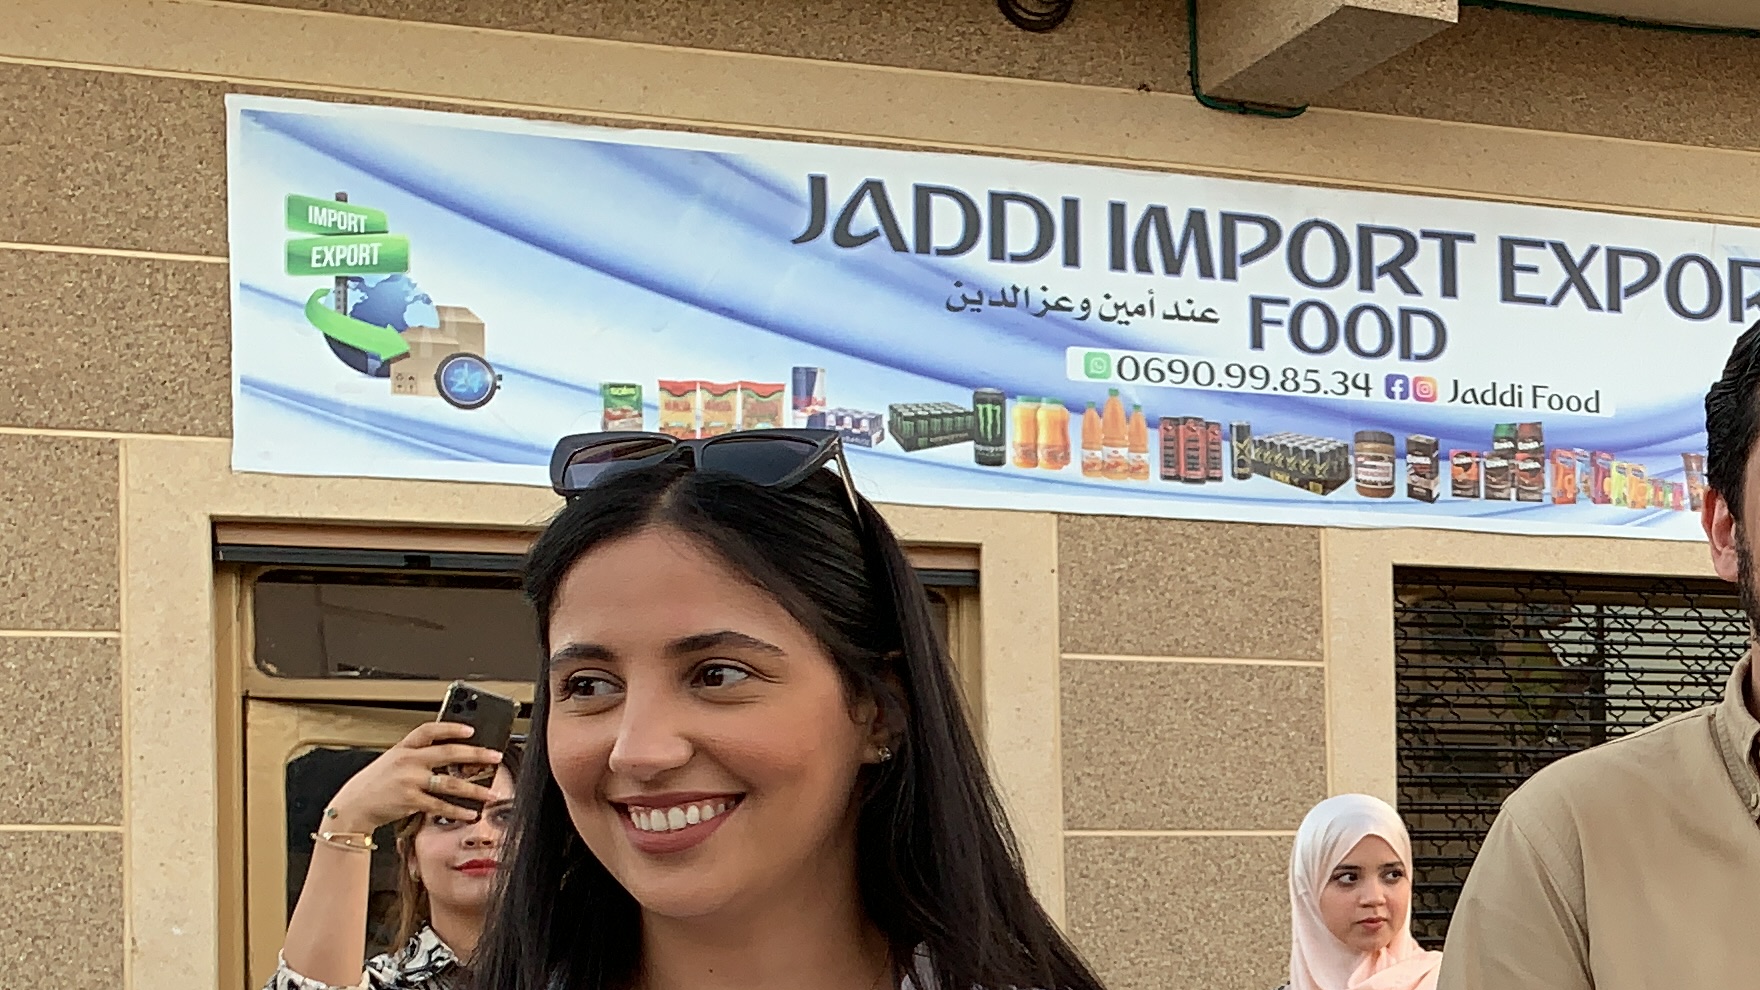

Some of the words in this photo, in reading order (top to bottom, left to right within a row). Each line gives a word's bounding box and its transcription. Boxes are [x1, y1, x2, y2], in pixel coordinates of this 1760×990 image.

[308, 205, 368, 233] IMPORT
[790, 173, 1081, 271] JADDI
[1109, 202, 1475, 299] IMPORT
[311, 243, 382, 267] EXPORT
[1248, 297, 1448, 363] FOOD
[1116, 354, 1374, 399] 0690.99.85.34
[1447, 379, 1524, 410] Jaddi
[1532, 384, 1602, 415] Food
